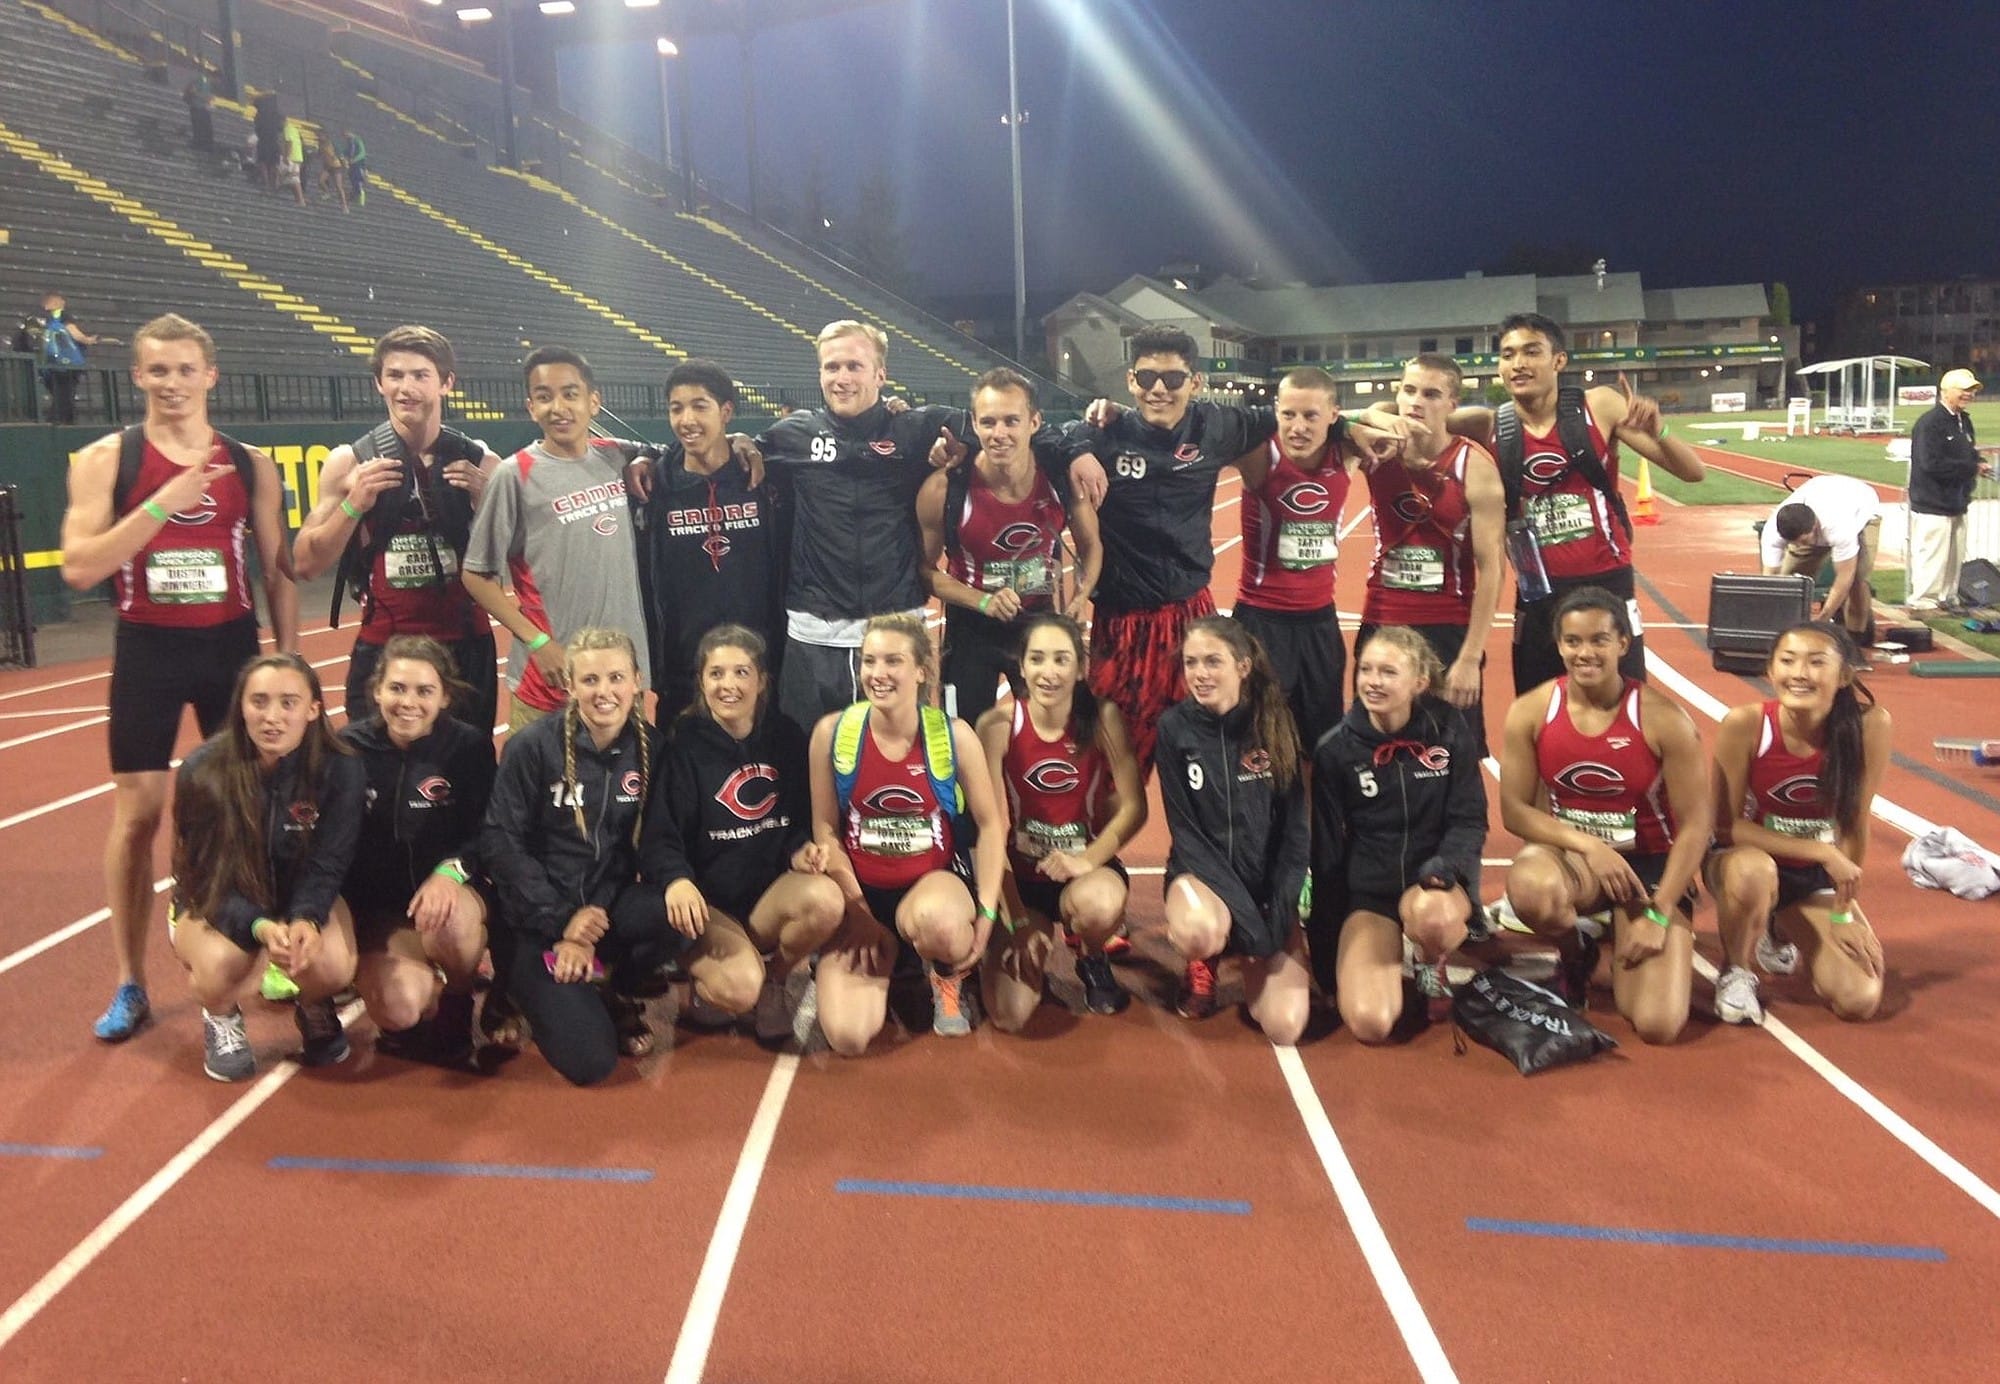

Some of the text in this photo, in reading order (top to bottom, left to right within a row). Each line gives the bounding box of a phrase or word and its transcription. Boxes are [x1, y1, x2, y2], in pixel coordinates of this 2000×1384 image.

[811, 437, 837, 462] 95
[1116, 455, 1147, 479] 69
[558, 504, 599, 525] TRACK
[667, 502, 759, 526] CAMAS
[668, 524, 708, 536] TRACK
[724, 518, 760, 530] FIELD
[1188, 762, 1204, 790] 9
[1359, 770, 1379, 797] 5
[550, 781, 584, 807] 14
[714, 763, 779, 820] C
